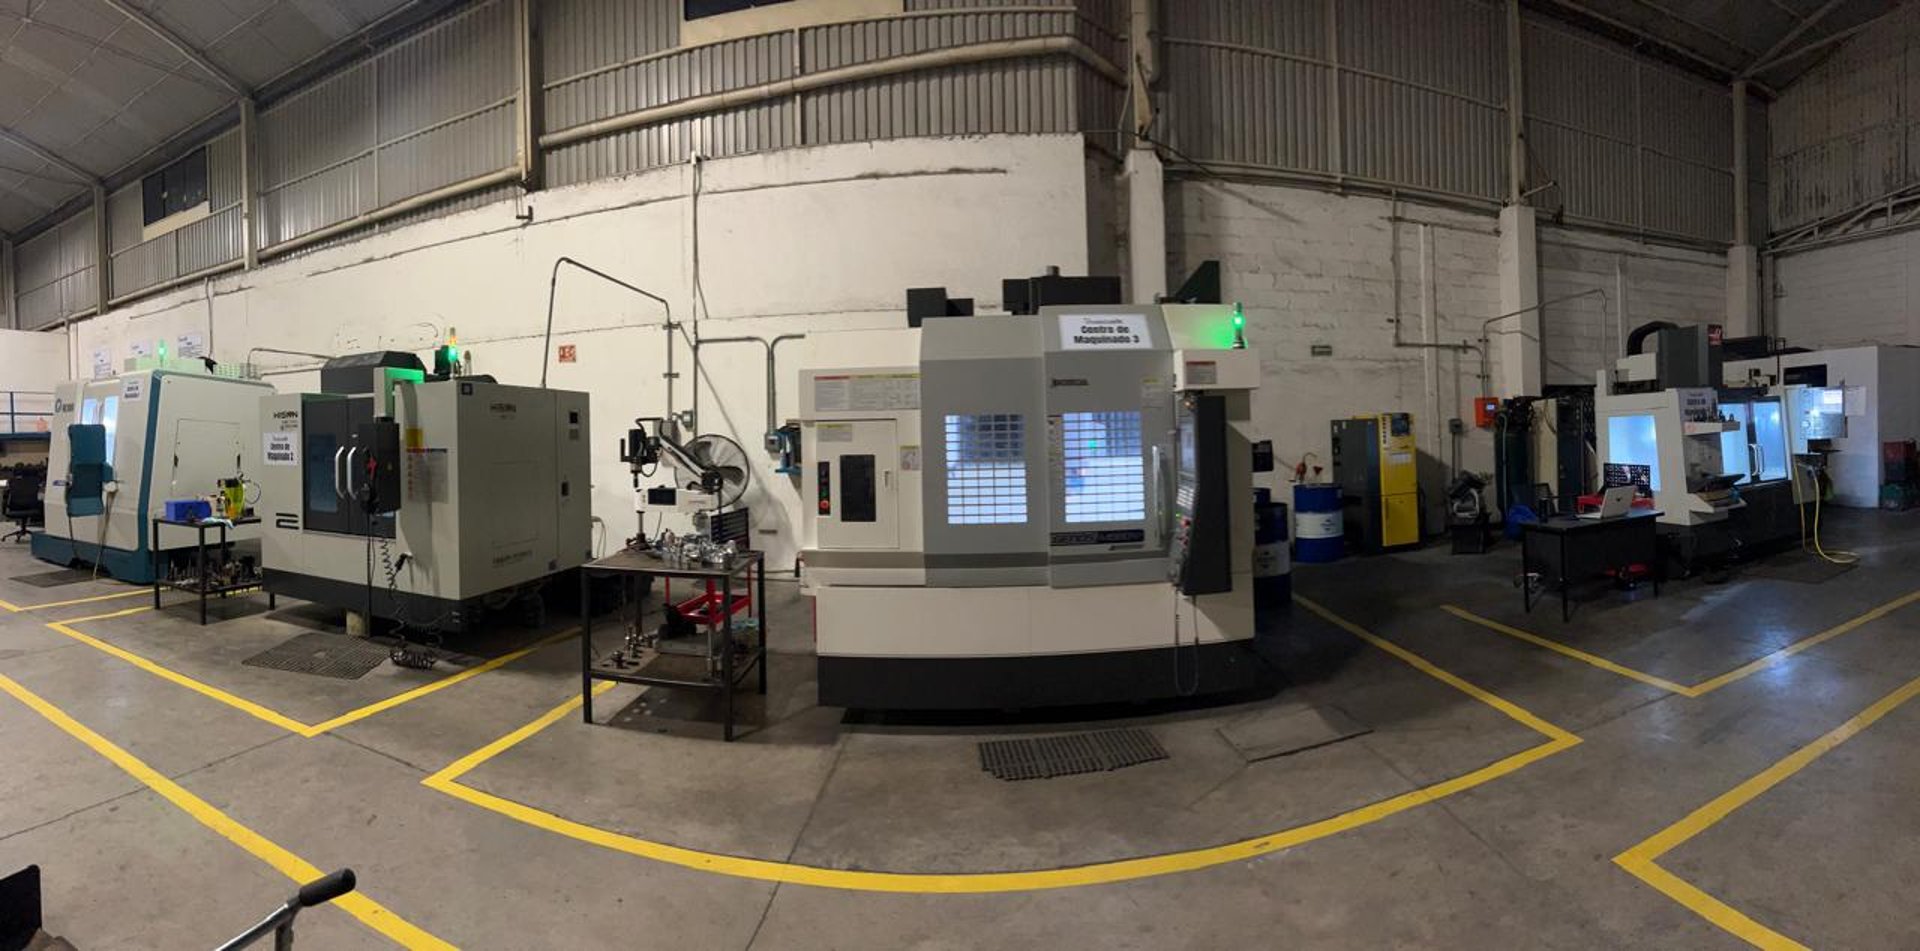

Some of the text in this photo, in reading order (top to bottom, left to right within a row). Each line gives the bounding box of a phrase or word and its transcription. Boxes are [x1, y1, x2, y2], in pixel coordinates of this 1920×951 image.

[1081, 325, 1129, 334] Centro de
[1073, 335, 1140, 345] Maquinado 3
